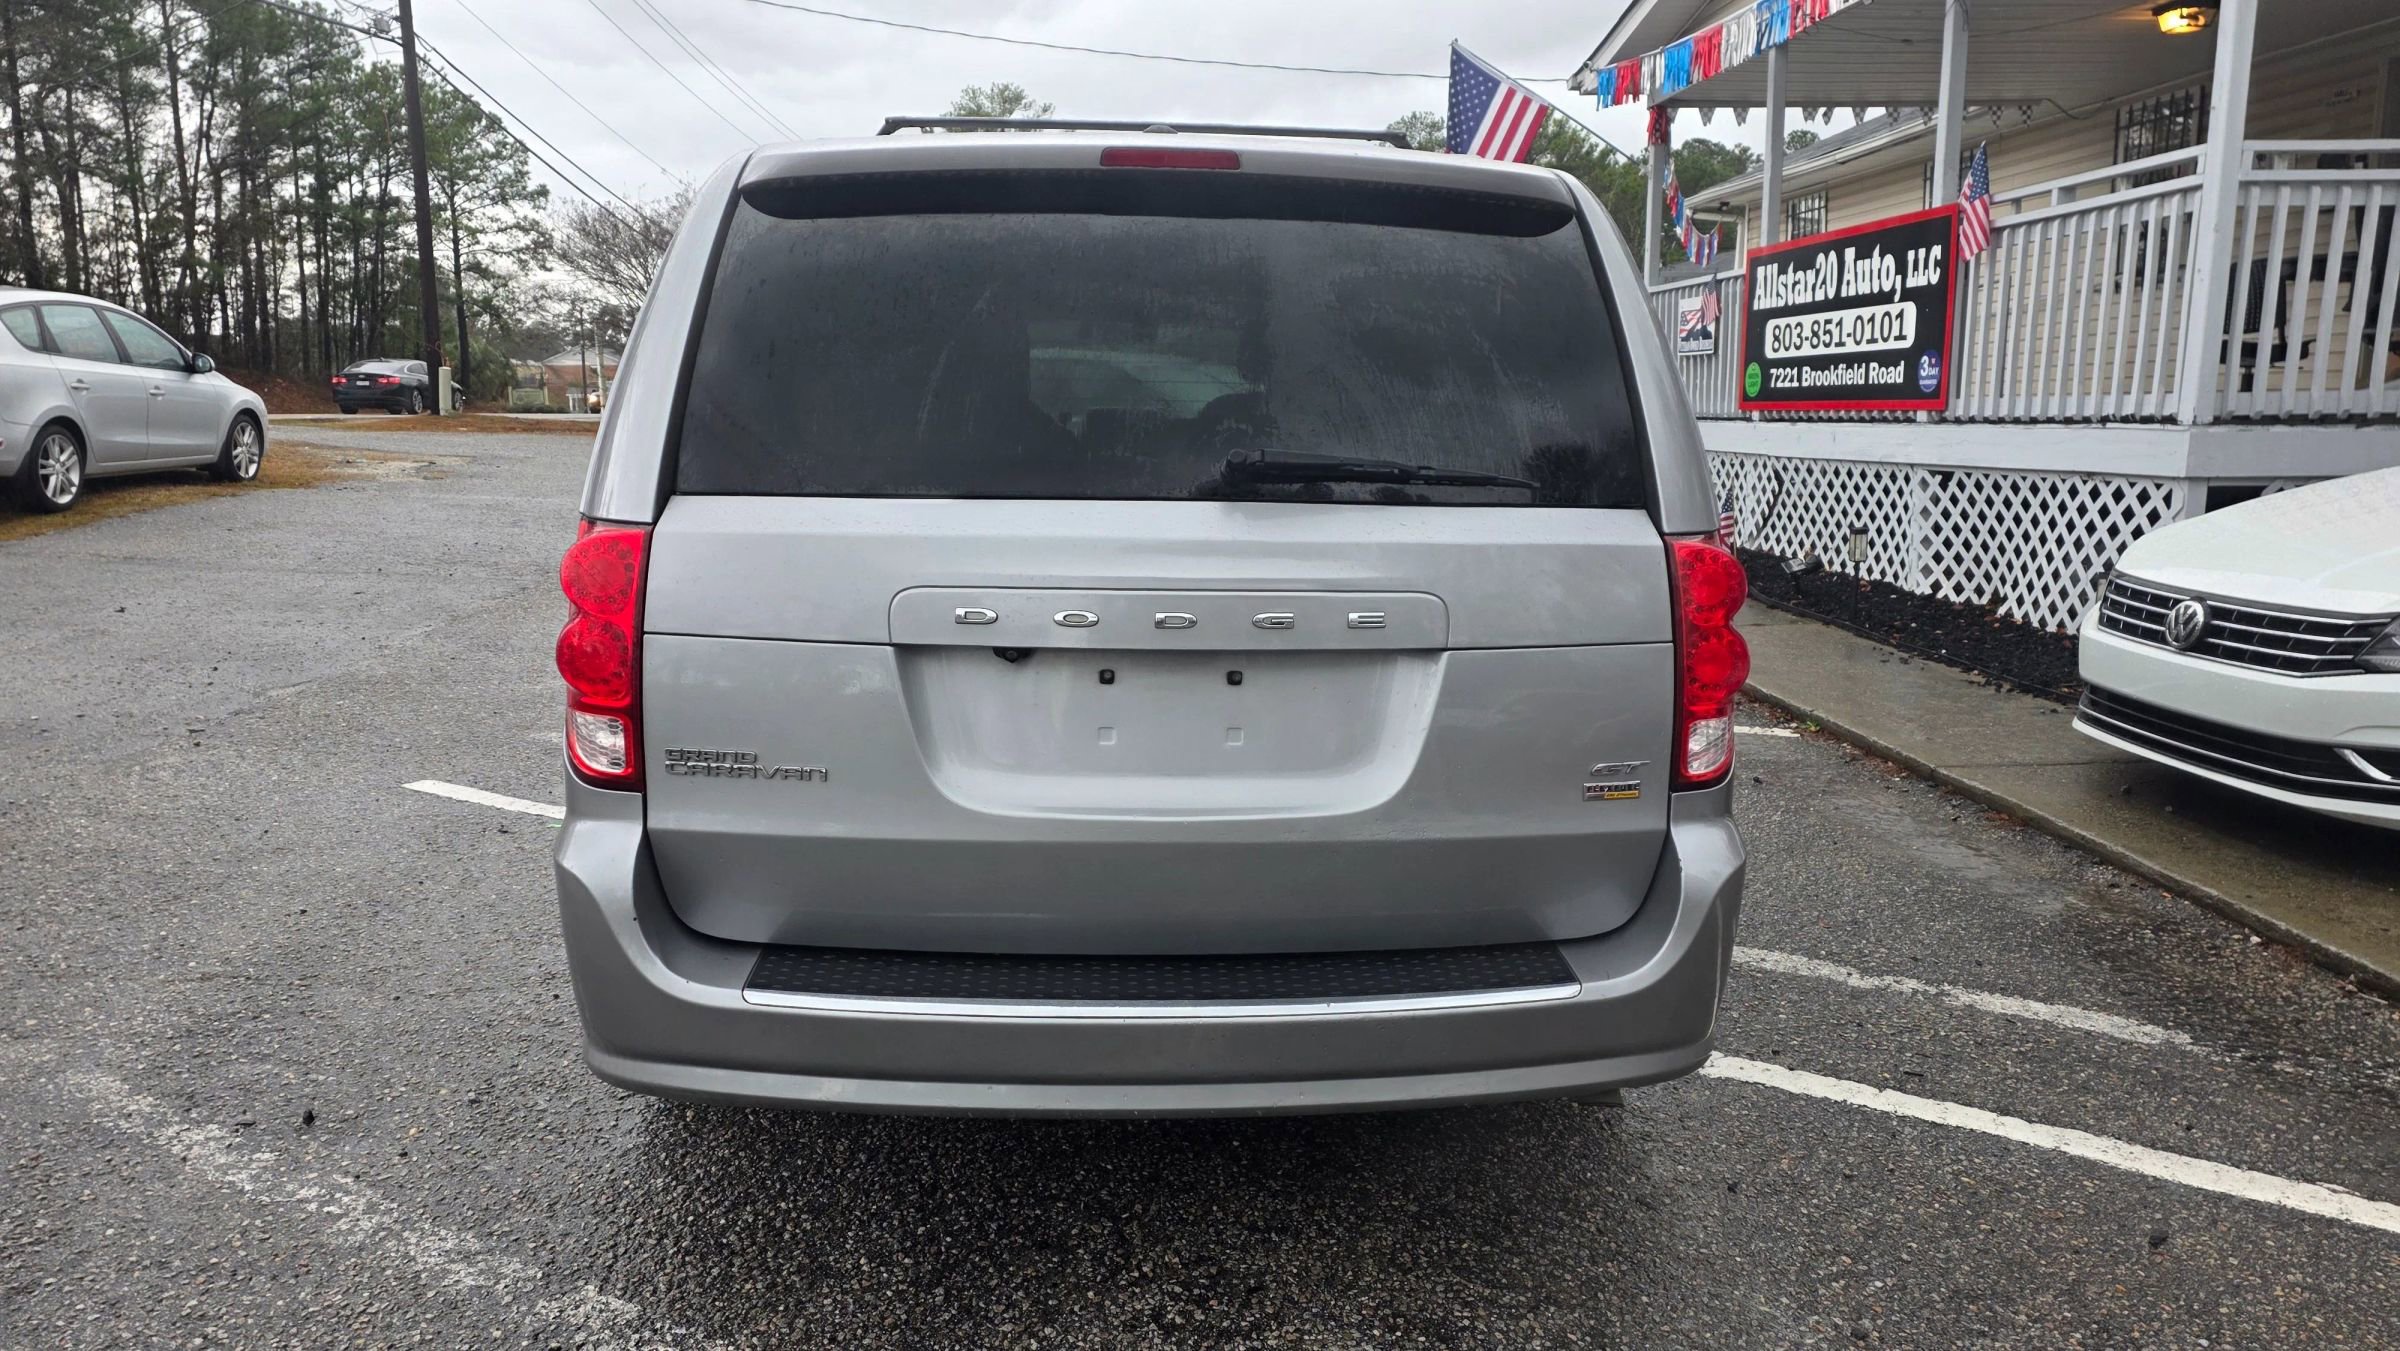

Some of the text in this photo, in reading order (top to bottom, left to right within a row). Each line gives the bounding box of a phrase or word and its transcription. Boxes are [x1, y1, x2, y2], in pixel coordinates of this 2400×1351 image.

[1753, 243, 1942, 311] Allstar20 Auto, LLC
[1771, 308, 1908, 353] 803-851-0101
[1769, 360, 1905, 388] 7221 Brookfield Road
[1920, 355, 1940, 377] 3 DAY
[954, 606, 1386, 630] DODGE
[664, 747, 758, 764] GRAND
[664, 760, 829, 783] CARAVAN
[1591, 760, 1651, 777] GT
